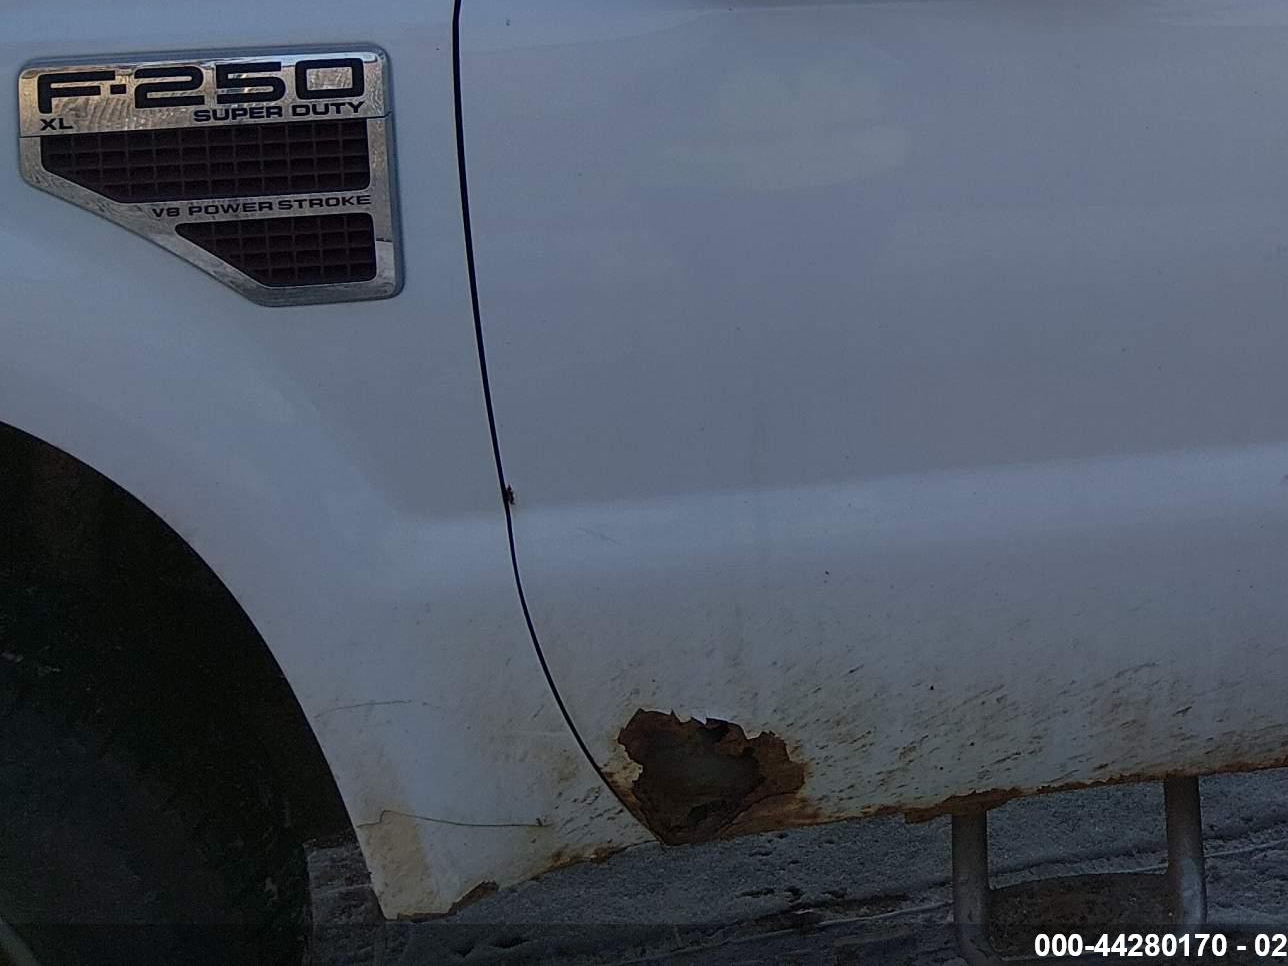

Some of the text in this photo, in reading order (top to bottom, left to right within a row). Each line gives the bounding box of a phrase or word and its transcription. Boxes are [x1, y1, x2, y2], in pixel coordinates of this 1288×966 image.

[37, 57, 366, 114] F-250
[193, 100, 366, 123] SUPER DUTY
[40, 117, 74, 131] XL
[151, 194, 373, 219] V8 POWER STROKE
